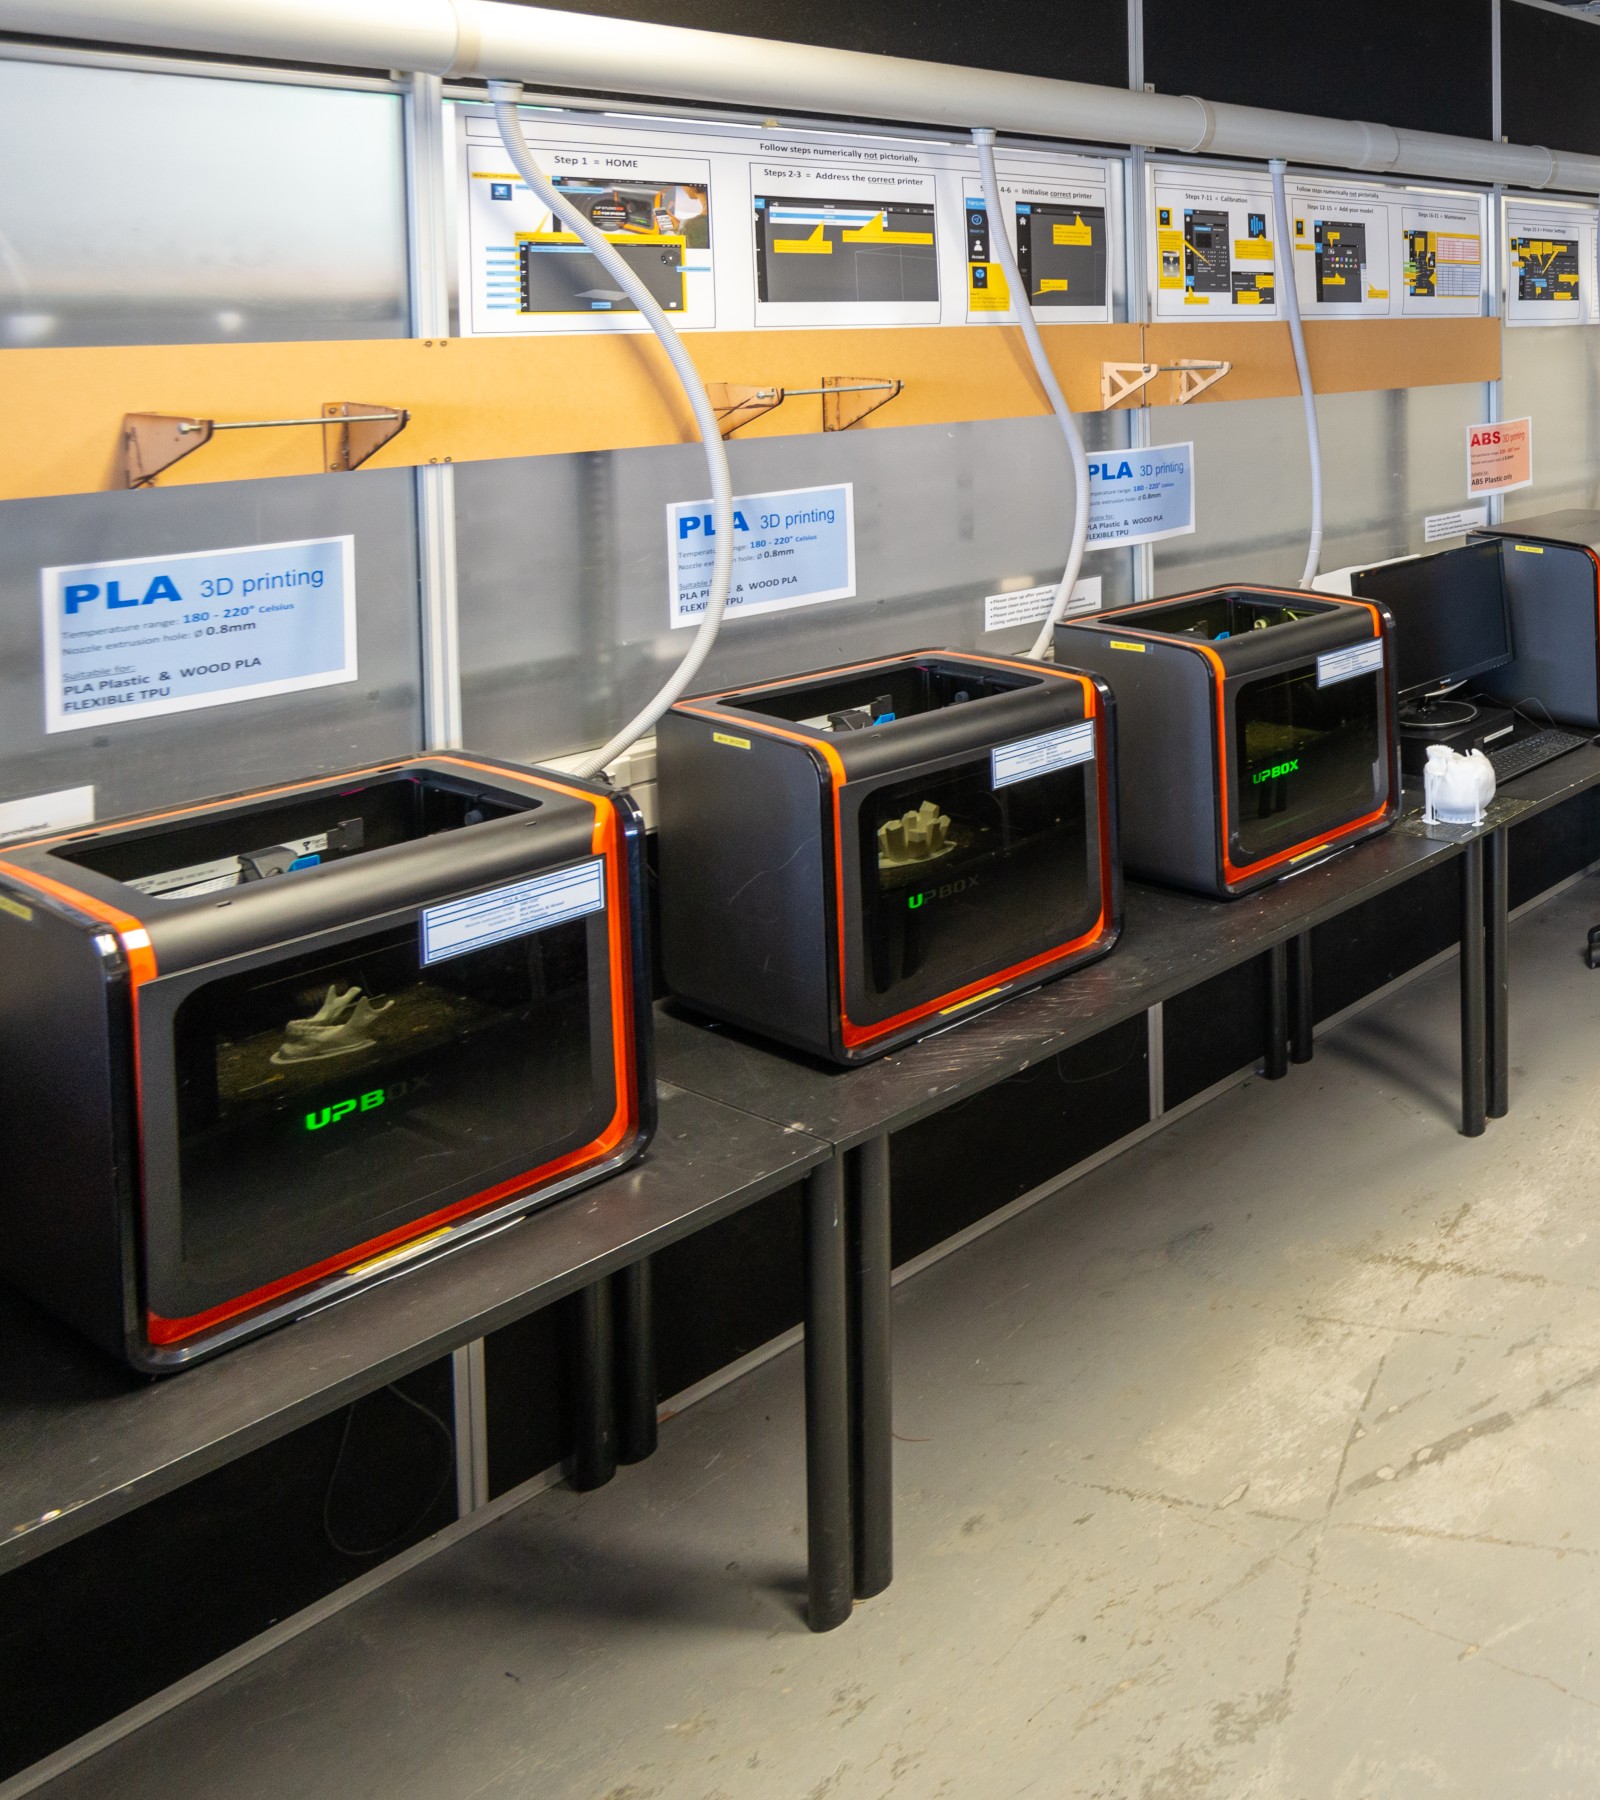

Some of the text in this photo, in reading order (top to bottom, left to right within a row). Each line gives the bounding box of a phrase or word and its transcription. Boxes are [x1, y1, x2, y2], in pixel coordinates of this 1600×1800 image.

[554, 155, 579, 167] Step
[606, 159, 638, 168] HOME
[760, 143, 788, 152] Follow
[790, 146, 811, 155] steps
[813, 148, 862, 159] numerically
[879, 153, 919, 163] pictorially.
[764, 169, 786, 178] Steps
[788, 170, 801, 178] 2-3
[816, 172, 850, 181] Address
[867, 176, 895, 184] correct
[897, 177, 923, 186] printer
[1022, 188, 1048, 197] Initialise
[1185, 193, 1200, 201] Steps
[1323, 189, 1348, 197] numerically
[1307, 203, 1318, 211] Steps
[1444, 213, 1467, 221] Maintenance
[1471, 431, 1501, 447] ABS
[1088, 461, 1184, 482] PLA 3D printing
[1472, 473, 1512, 486] ABS Plastic only
[1142, 492, 1162, 501] 0.8mm
[760, 515, 780, 530] 3D
[785, 508, 835, 529] printing
[1099, 520, 1120, 530] Plastic
[1132, 516, 1152, 525] WOOD
[1153, 514, 1163, 522] PLA
[1116, 529, 1129, 537] TPU
[678, 549, 715, 559] Temperat
[750, 539, 766, 549] 180
[678, 561, 702, 571] Nozzle
[738, 555, 756, 563] hole:
[764, 548, 794, 559] 0.8mm
[64, 568, 324, 615] PLA 3D printing
[679, 579, 708, 590] Suitable
[680, 591, 697, 601] PLA
[736, 584, 744, 592] &
[749, 579, 779, 591] WOOD
[781, 576, 797, 585] PLA
[680, 597, 743, 613] FLEXI TPU
[62, 601, 295, 642] Temperature range: 180 220° Celsius
[62, 620, 257, 657] Nozzle extrusion hole: 0.8mm
[62, 663, 136, 684] Suitable for:
[63, 656, 262, 697] PLA Plastic & WOOD PLA
[63, 686, 171, 713] FLEXIBLE TPU
[1252, 759, 1299, 784] UPBOX
